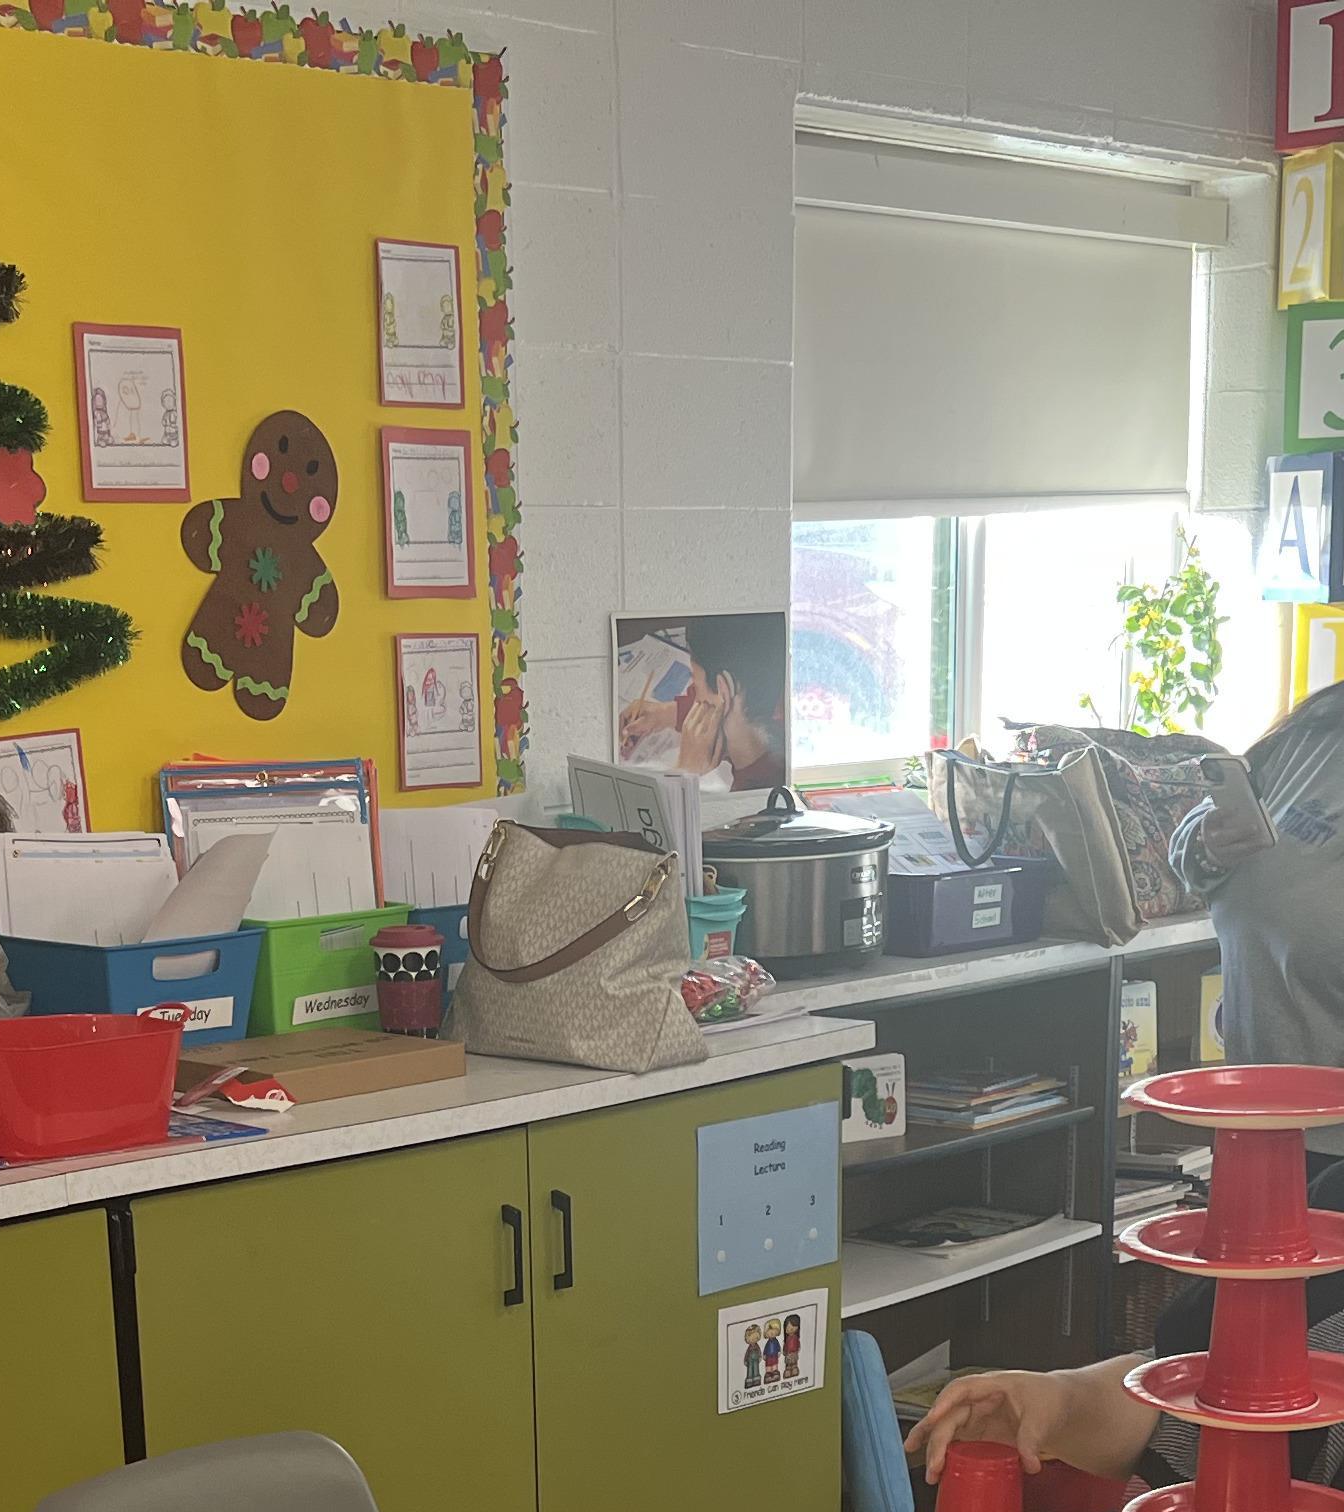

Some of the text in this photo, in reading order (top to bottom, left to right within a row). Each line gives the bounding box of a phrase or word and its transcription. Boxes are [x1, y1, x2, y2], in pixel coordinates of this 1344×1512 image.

[1289, 176, 1314, 284] 2
[304, 992, 371, 1014] Wednesday
[159, 1006, 212, 1023] Tueday
[753, 1139, 786, 1154] Reading
[754, 1161, 786, 1176] Lectura
[809, 1194, 816, 1206] 3
[765, 1204, 772, 1216] 2
[719, 1214, 724, 1226] 1
[743, 1386, 766, 1399] Friends
